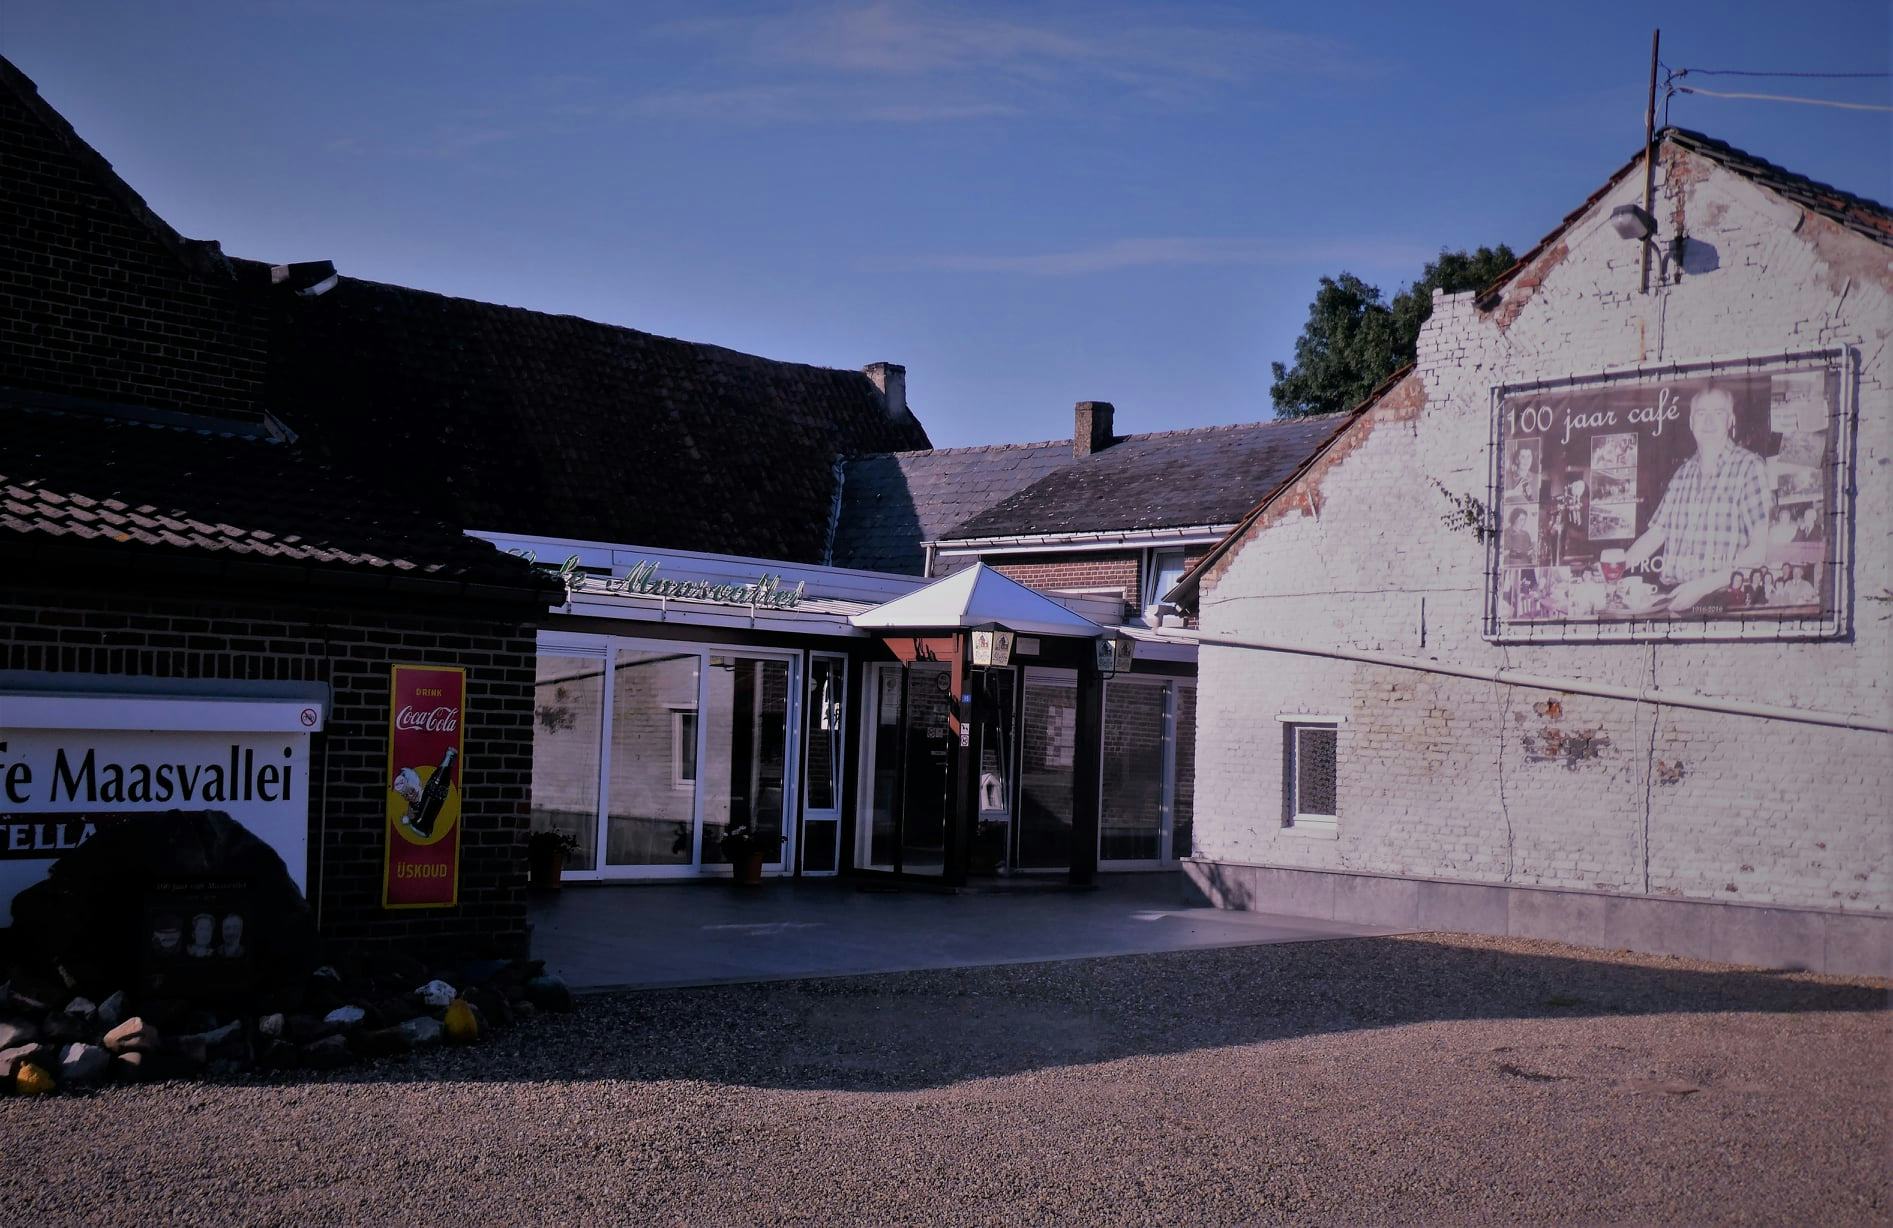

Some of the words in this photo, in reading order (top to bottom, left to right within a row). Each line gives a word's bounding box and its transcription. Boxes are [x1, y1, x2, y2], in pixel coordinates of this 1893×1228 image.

[1507, 406, 1553, 434] 100
[1561, 408, 1617, 445] jaar
[1628, 388, 1680, 436] café
[415, 688, 442, 696] DRINK
[396, 705, 459, 732] Coca-Cola
[50, 745, 292, 803] Maasvallei
